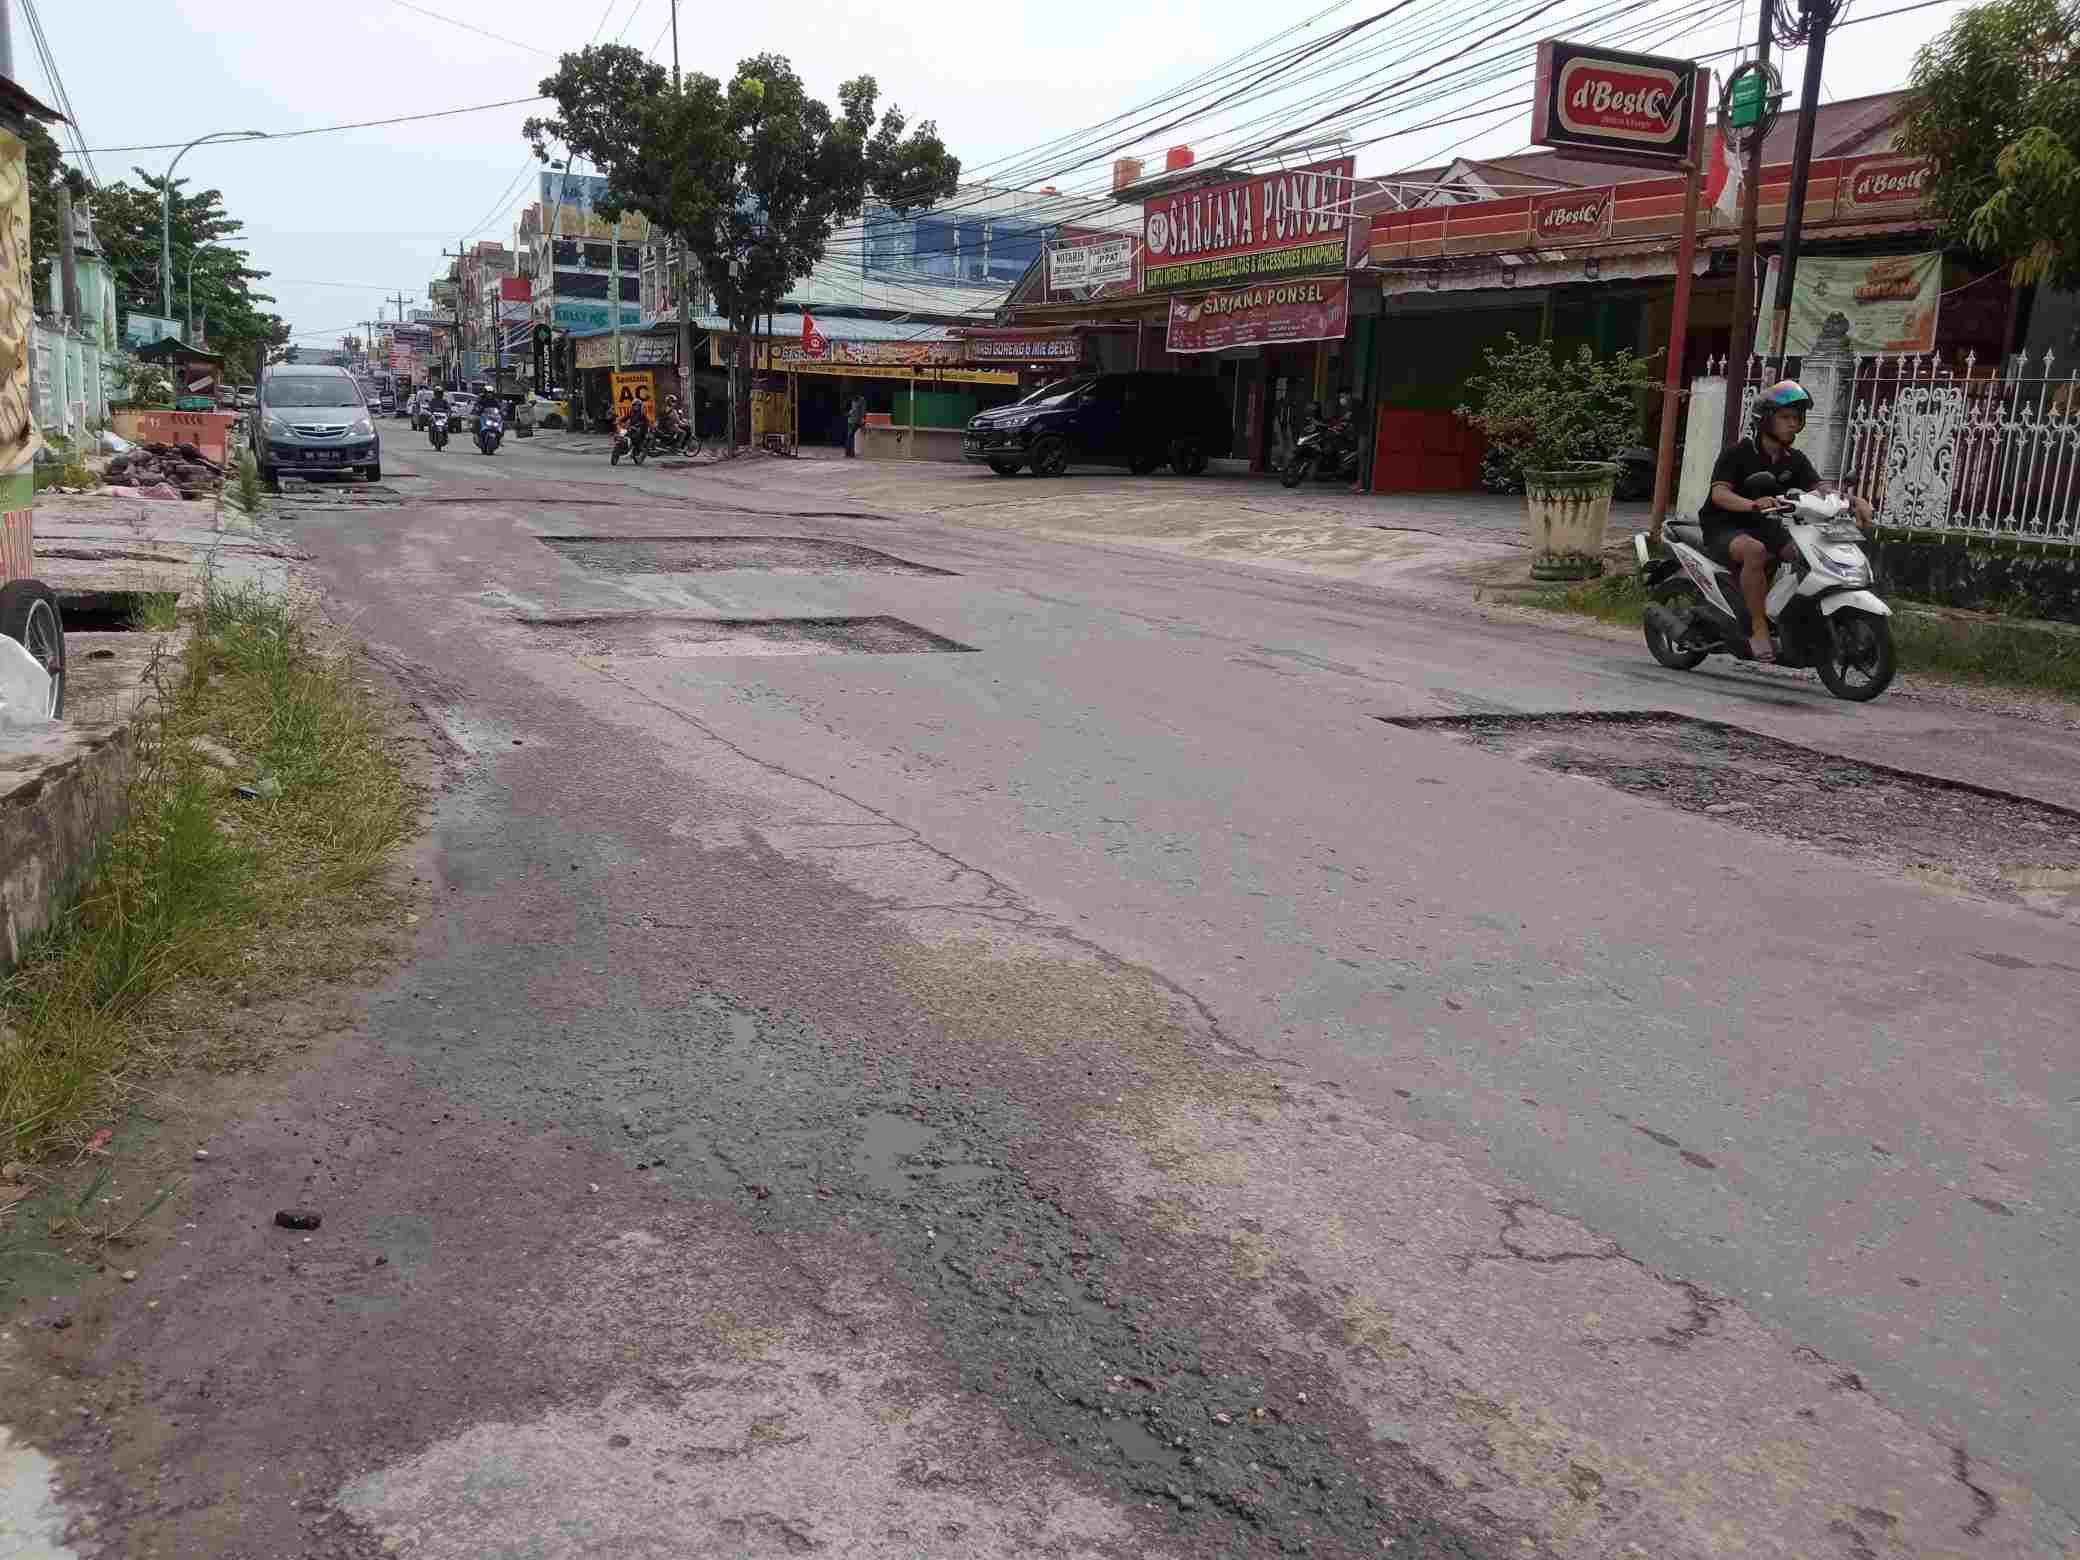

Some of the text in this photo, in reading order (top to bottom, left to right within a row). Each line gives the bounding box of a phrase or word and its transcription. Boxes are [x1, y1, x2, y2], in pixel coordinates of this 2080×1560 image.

[1168, 166, 1344, 256] SARJANA PONSEL
[1203, 283, 1324, 315] SARJANA PONSEL
[619, 384, 651, 403] AC
